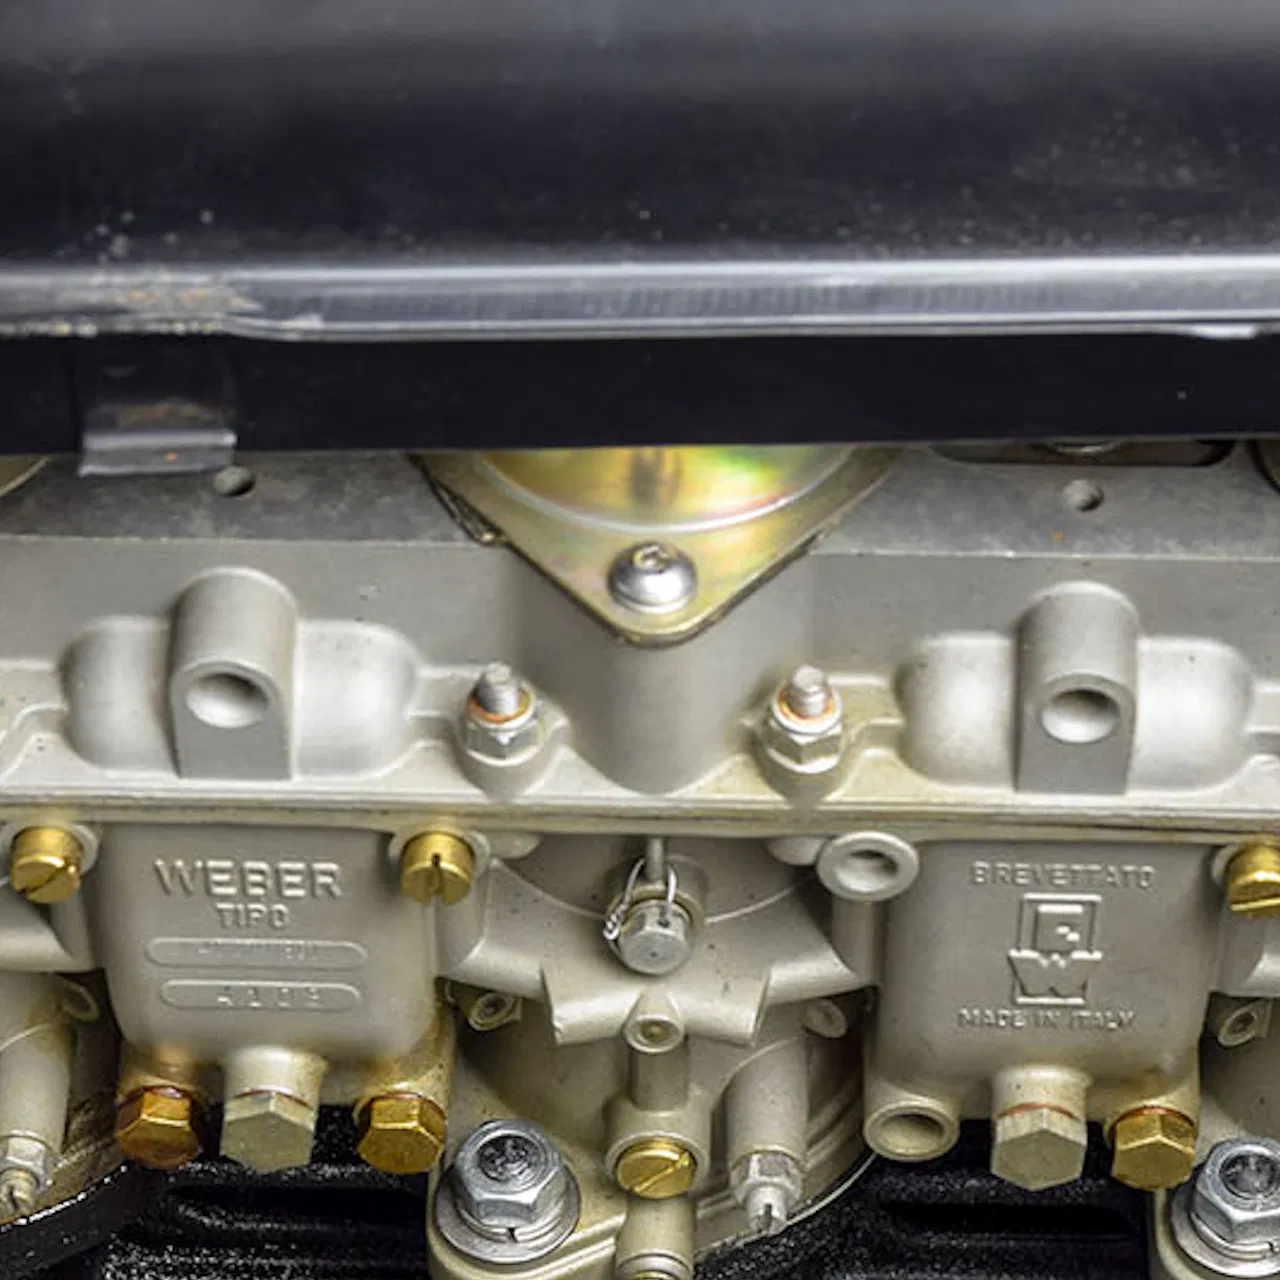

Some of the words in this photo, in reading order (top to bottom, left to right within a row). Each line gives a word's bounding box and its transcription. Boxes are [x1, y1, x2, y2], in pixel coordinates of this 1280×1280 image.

[154, 857, 343, 899] WEBER
[972, 861, 1155, 888] BREVETTATO
[215, 902, 291, 928] TIPO
[957, 1008, 1025, 1028] MADE
[1032, 1010, 1061, 1029] IN
[1069, 1010, 1135, 1030] ITALY
